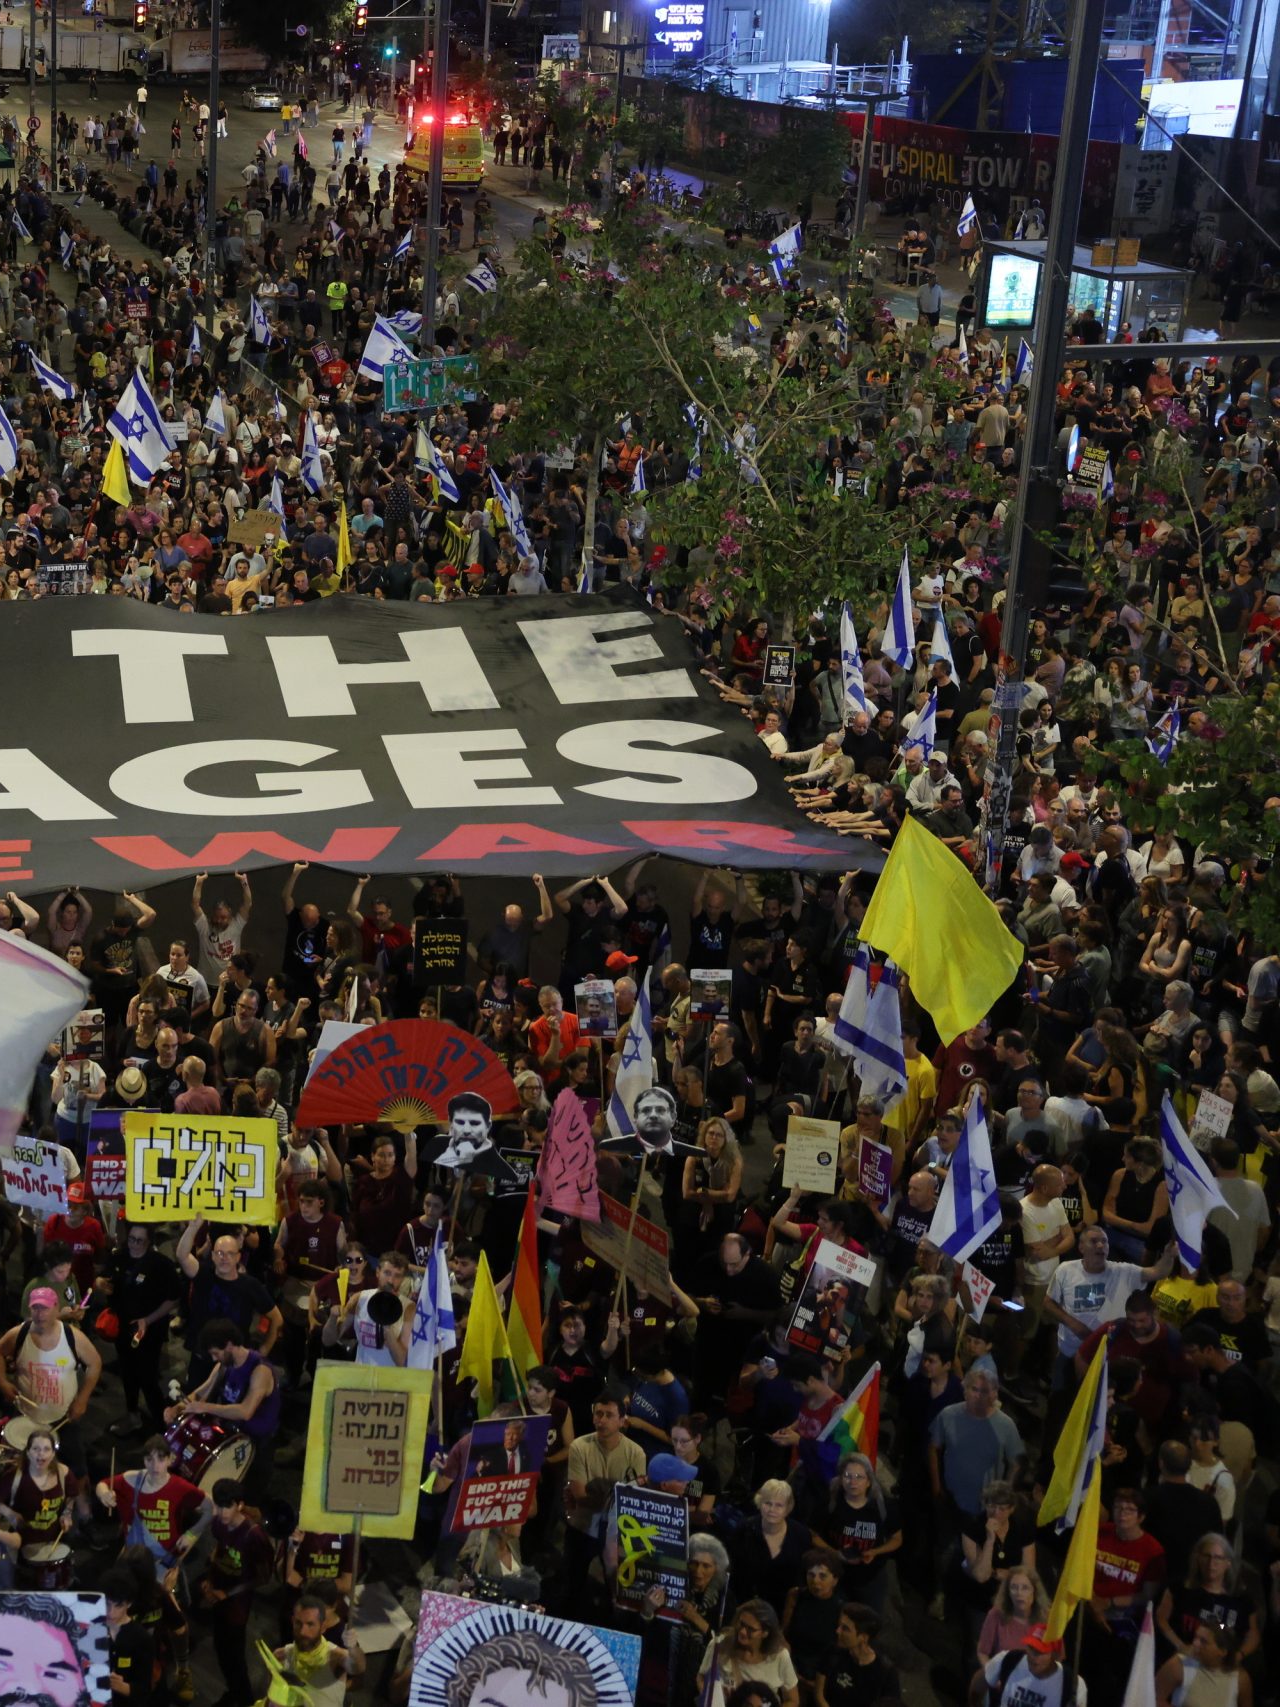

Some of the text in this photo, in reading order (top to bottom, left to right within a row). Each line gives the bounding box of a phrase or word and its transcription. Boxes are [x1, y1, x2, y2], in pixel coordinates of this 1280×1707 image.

[898, 145, 960, 185] SPIRAL
[961, 155, 1052, 192] TOWR
[72, 610, 698, 723] THE
[91, 819, 851, 871] WAR
[421, 930, 461, 943] ממשלת
[421, 946, 460, 956] הסטרא
[425, 958, 455, 968] אחרא
[436, 1036, 488, 1083] רק
[380, 1063, 449, 1097] הרוח
[43, 1146, 58, 1167] די
[92, 1160, 119, 1169] END
[48, 1185, 63, 1203] די
[90, 1181, 127, 1196] WA
[140, 1183, 246, 1212] הביתה!
[341, 1399, 405, 1418] מורשת
[338, 1422, 400, 1440] נתניהו:
[367, 1448, 401, 1467] בתי
[341, 1467, 401, 1487] קברות
[468, 1478, 531, 1495] END THIS
[620, 1496, 640, 1507] מדיני
[641, 1500, 674, 1514] לתהליך
[462, 1503, 523, 1527] WAR
[620, 1505, 648, 1519] משיחית
[649, 1511, 671, 1524] להזיה
[637, 1568, 653, 1579] היא
